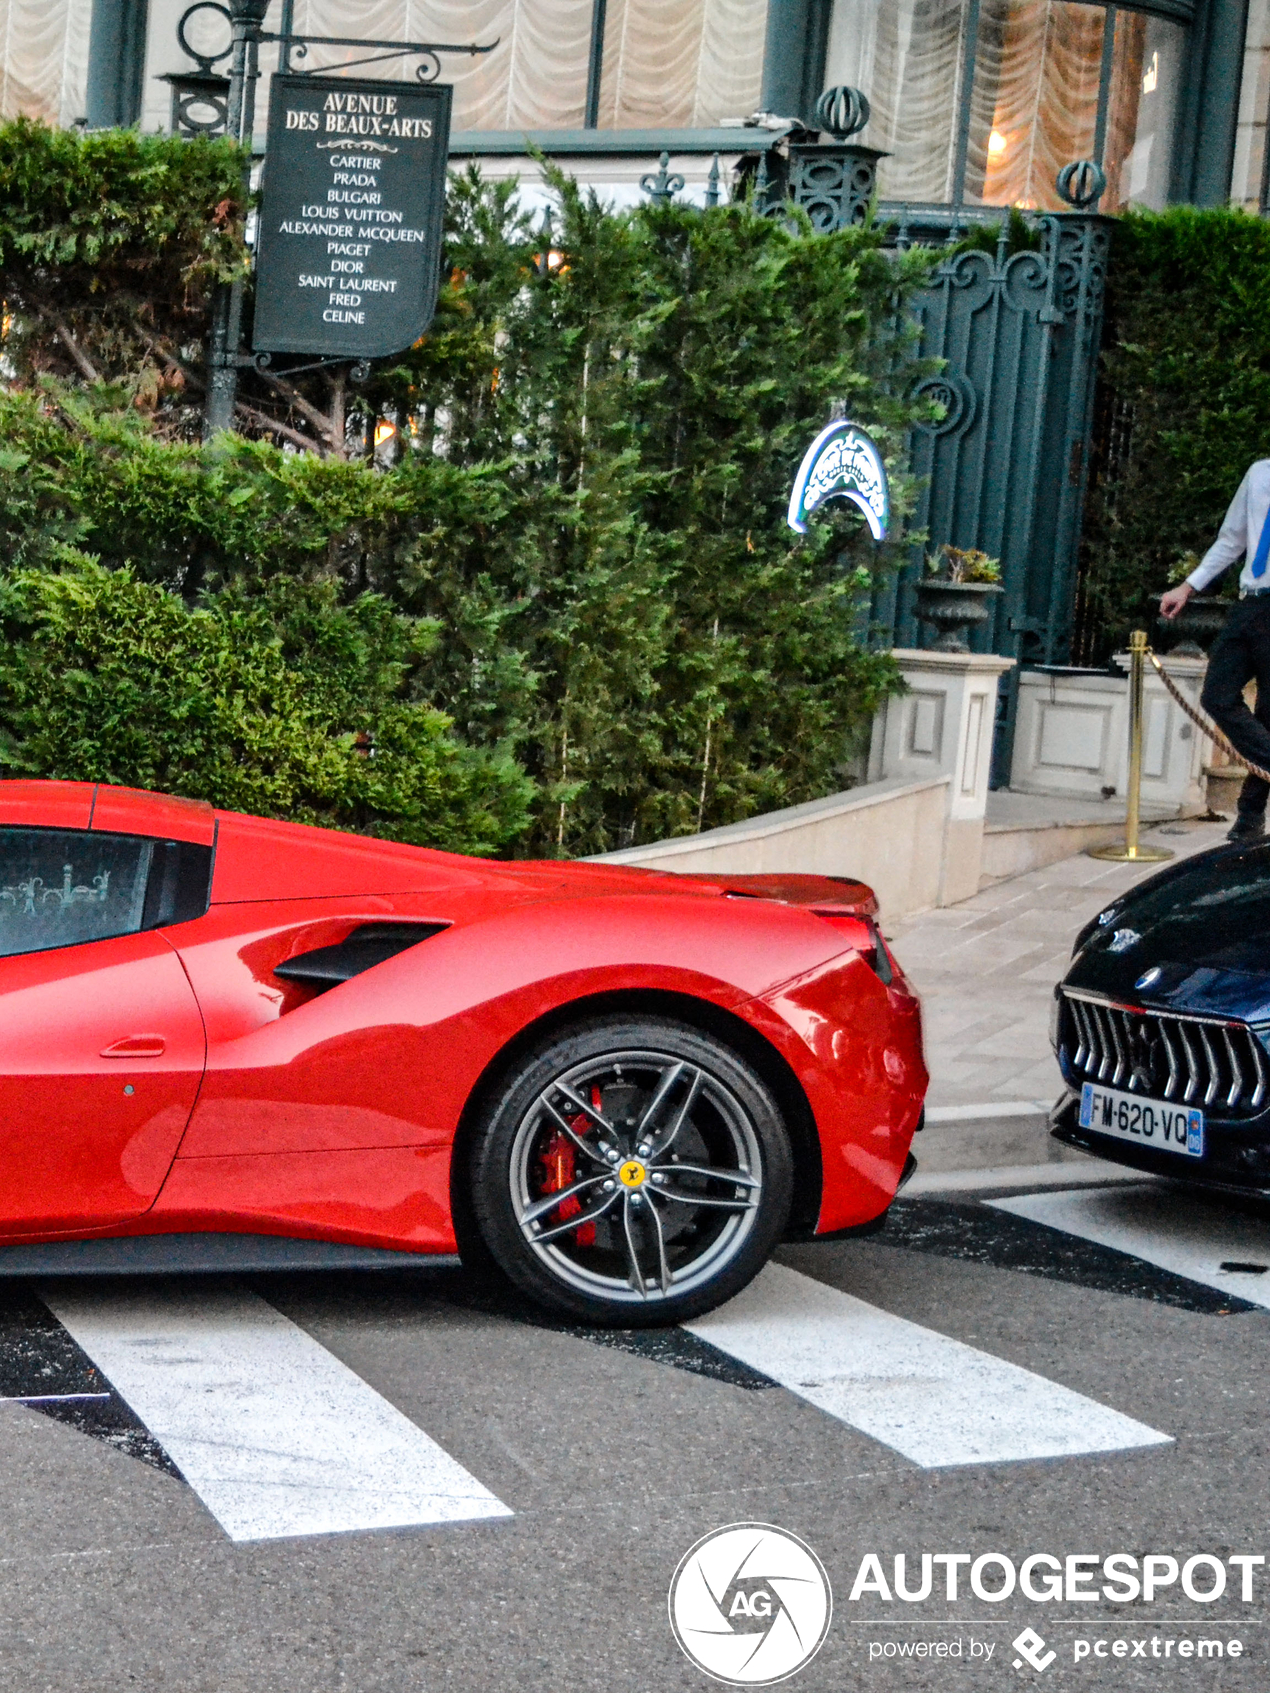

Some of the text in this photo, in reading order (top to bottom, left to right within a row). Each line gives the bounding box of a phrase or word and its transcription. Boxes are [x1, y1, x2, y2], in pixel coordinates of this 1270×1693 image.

[324, 94, 396, 114] AVENUE
[286, 111, 431, 137] DES BEAUX-ARTS
[330, 155, 380, 169] CARTIER
[334, 173, 376, 186] PRADA
[328, 190, 380, 204] BULGARI
[303, 206, 402, 222] LOUIS VUITTON
[280, 222, 423, 242] ALEXANDER MCQUEEN
[328, 243, 371, 256] PIAGET
[331, 260, 363, 273] DIOR
[299, 275, 397, 292] SAINT LAURENT
[330, 293, 361, 306] FRED
[323, 310, 364, 324] CELINE
